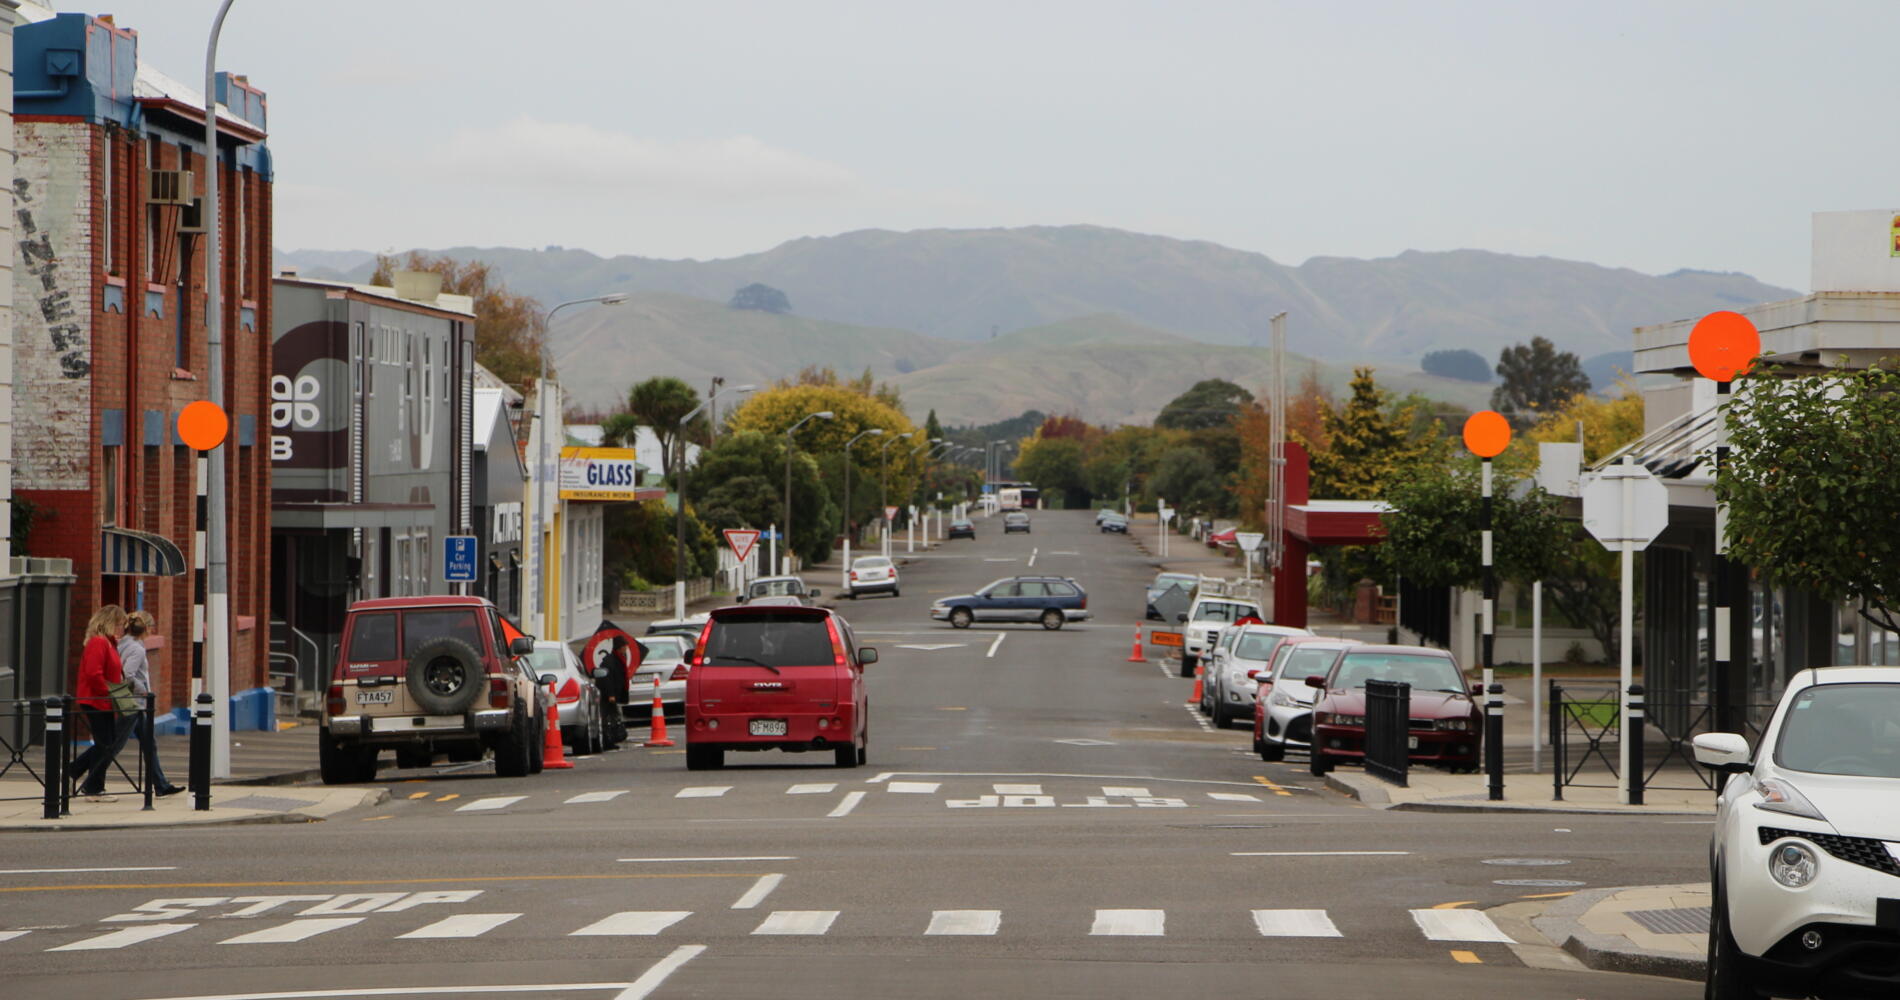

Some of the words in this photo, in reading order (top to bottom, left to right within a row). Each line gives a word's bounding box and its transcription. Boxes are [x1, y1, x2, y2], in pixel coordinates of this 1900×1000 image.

[587, 464, 632, 486] GLASS
[455, 553, 465, 561] Car
[449, 562, 471, 572] Parking
[357, 692, 391, 702] FTA457
[945, 795, 1188, 808] STOP
[99, 889, 486, 922] STOP
